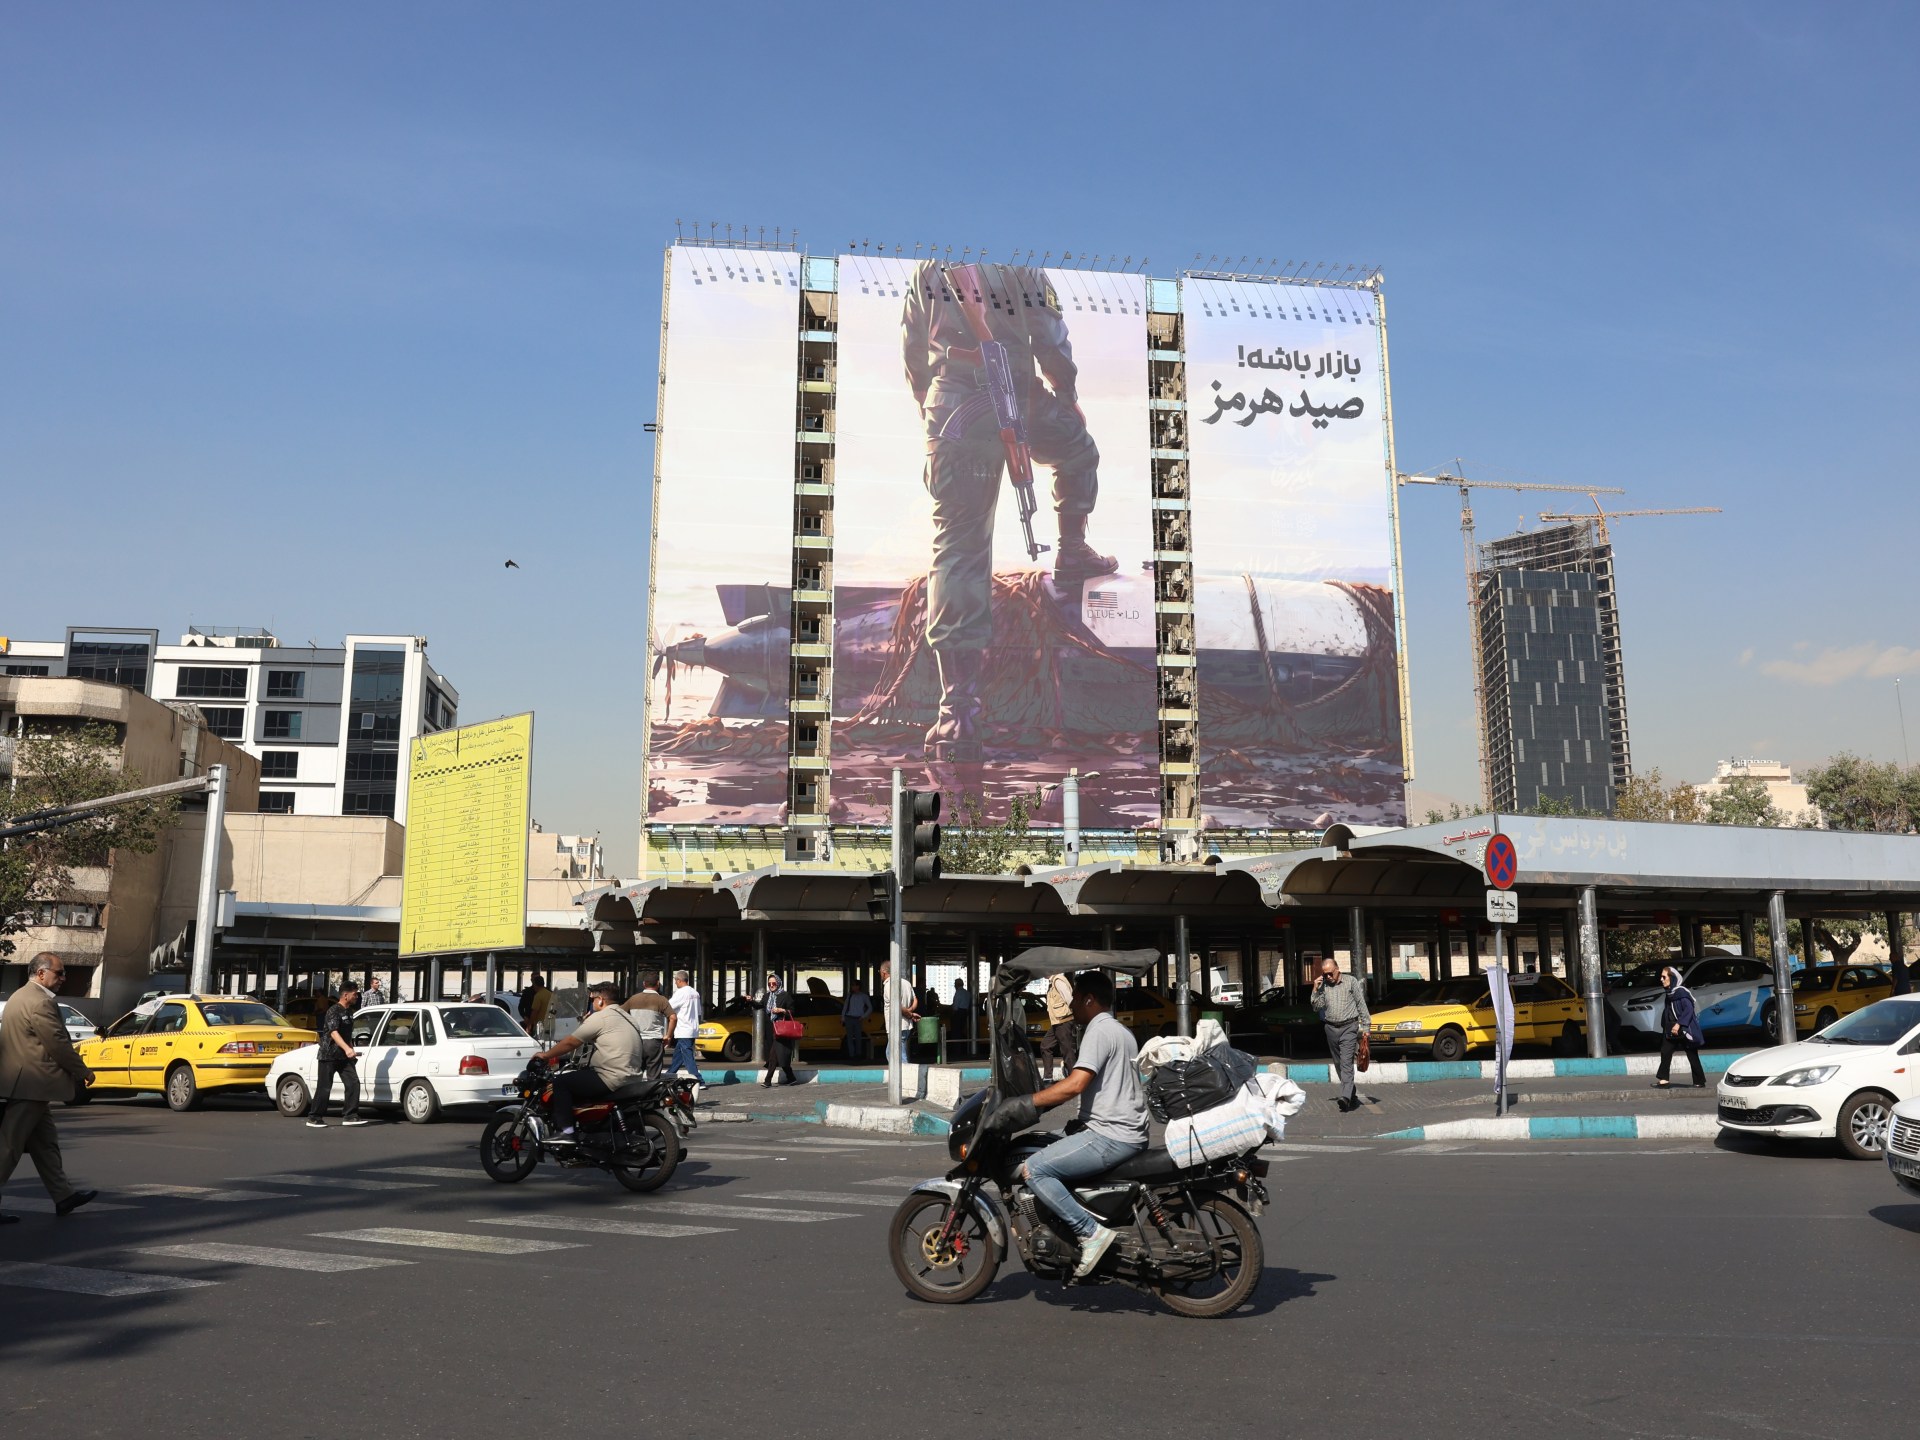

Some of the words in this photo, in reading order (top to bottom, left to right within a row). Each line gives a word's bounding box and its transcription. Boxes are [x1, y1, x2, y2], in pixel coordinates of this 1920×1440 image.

[1237, 345, 1311, 379] باشه!
[1314, 350, 1362, 383] بازار
[1199, 379, 1284, 428] هرمز
[1289, 389, 1365, 430] صید
[1087, 609, 1115, 619] DIVE
[1125, 610, 1140, 620] LD
